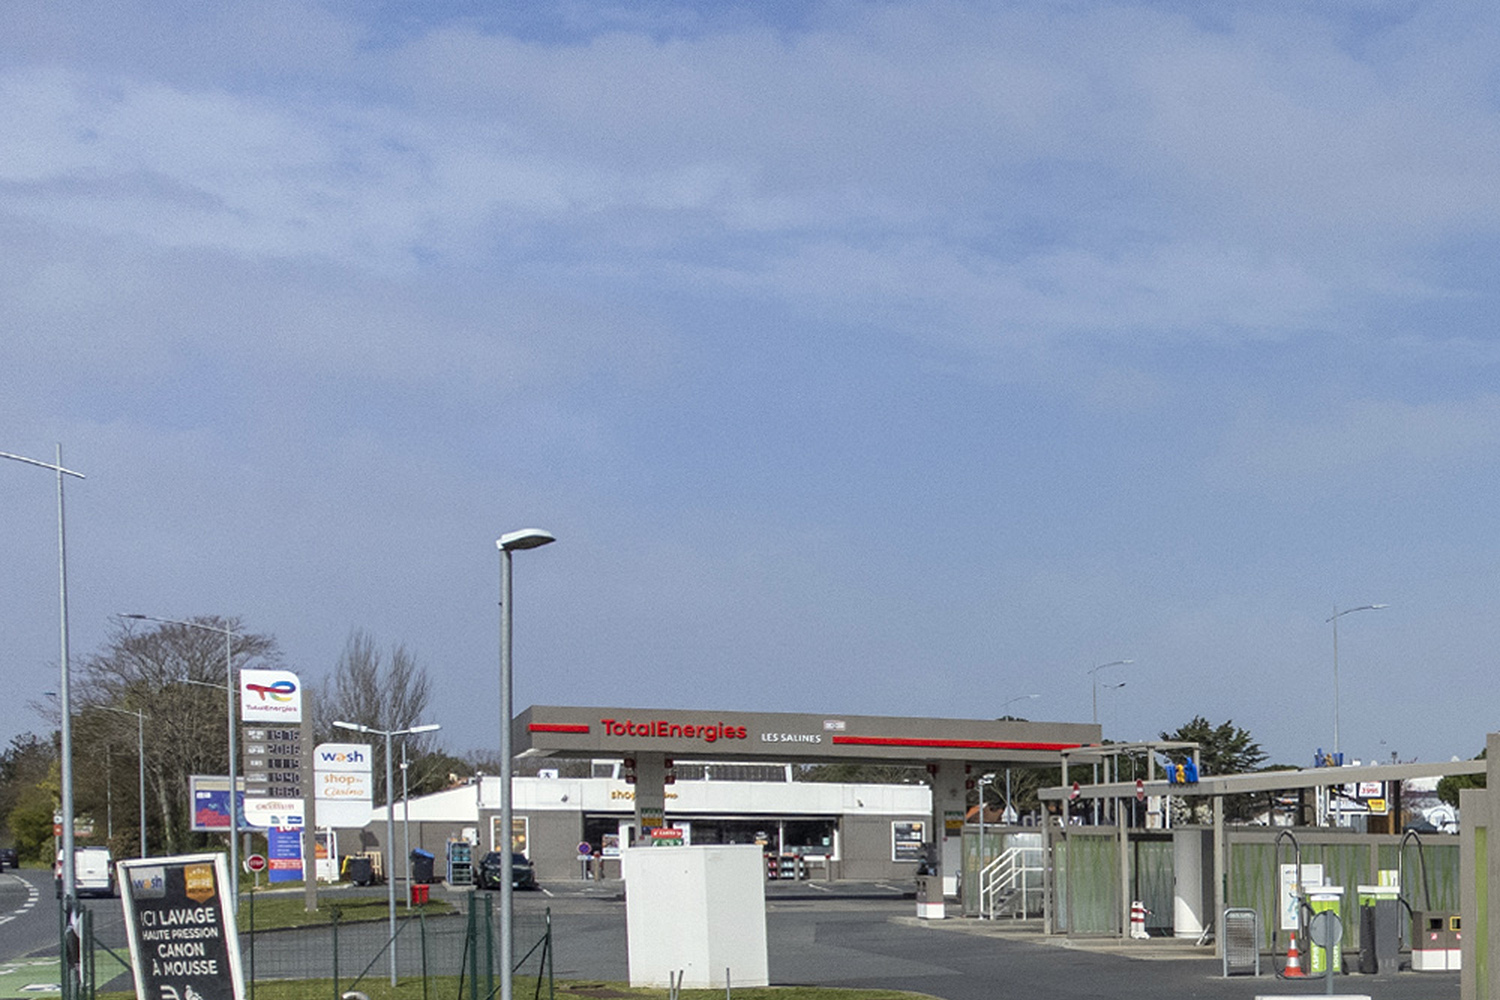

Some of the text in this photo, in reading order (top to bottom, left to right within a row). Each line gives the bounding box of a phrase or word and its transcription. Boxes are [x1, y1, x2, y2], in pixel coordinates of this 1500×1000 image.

[601, 718, 748, 743] TotalEnergies
[761, 732, 822, 744] LES SALINES
[321, 750, 364, 762] wash
[324, 773, 355, 785] shop
[324, 787, 364, 797] Casino
[132, 875, 163, 889] wash
[140, 907, 216, 927] ICI LAVAGE
[142, 926, 219, 941] HAUTE PRESSION
[157, 942, 206, 958] CANON
[152, 958, 219, 976] À MOUSSE
